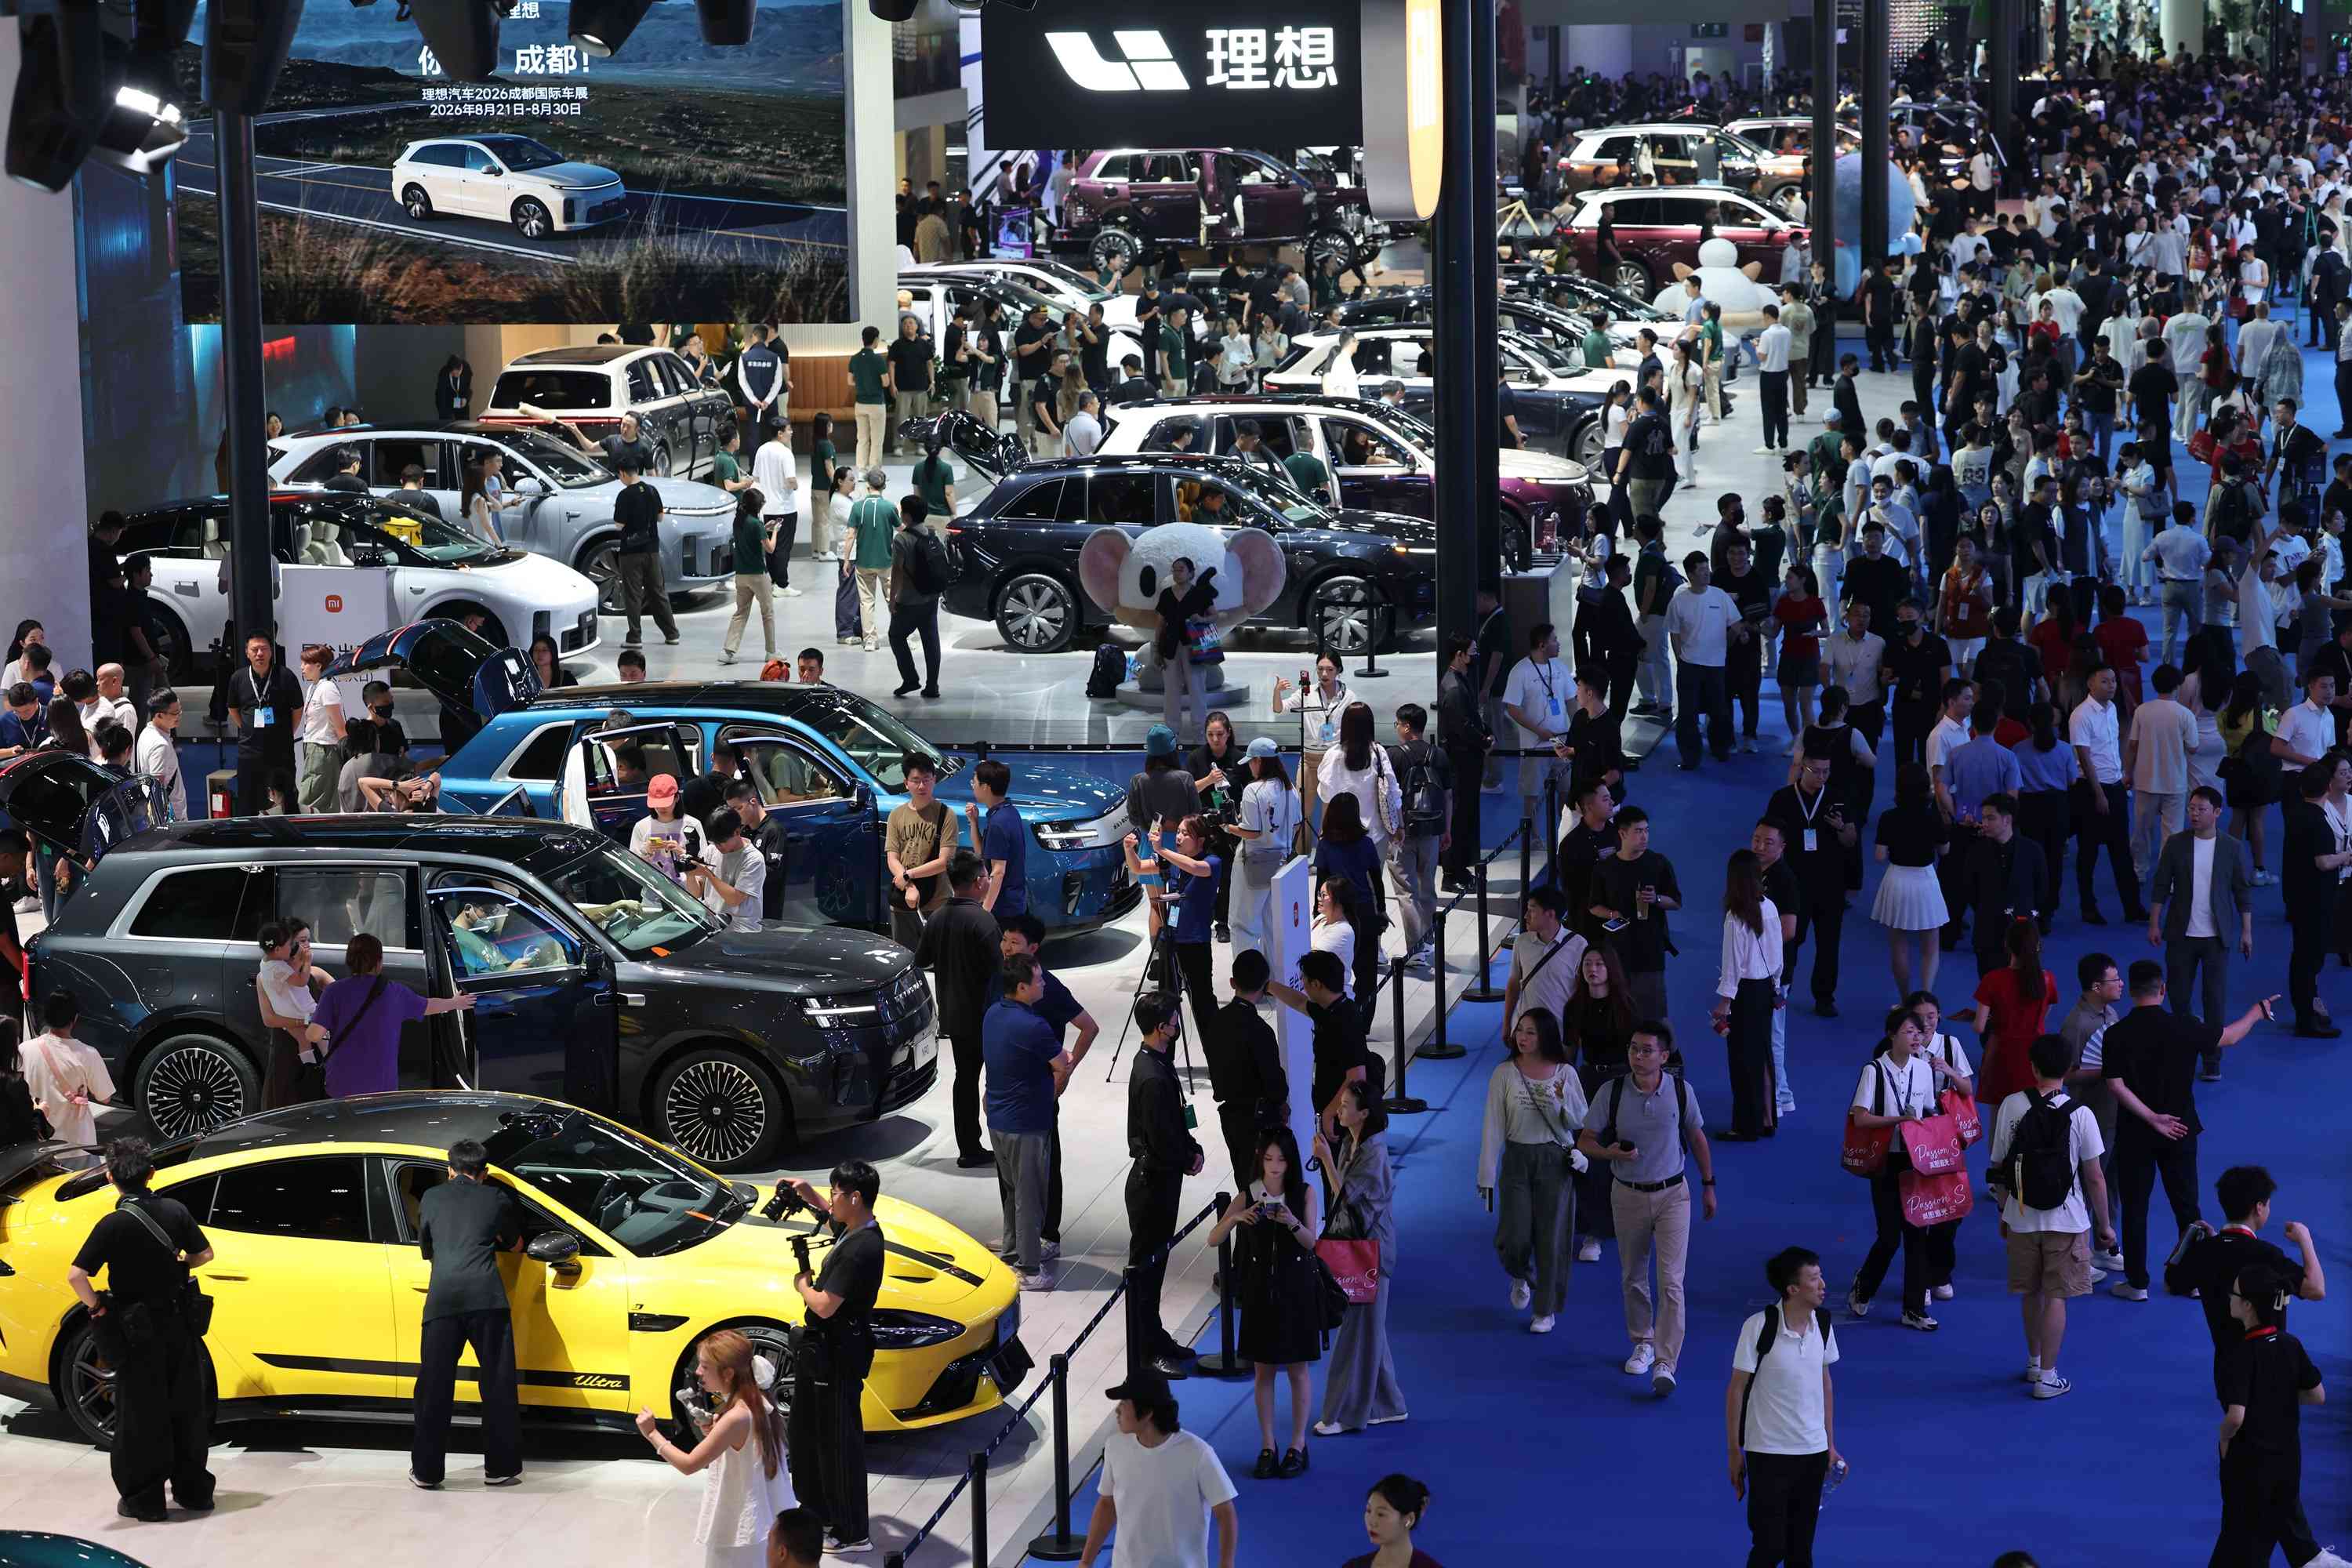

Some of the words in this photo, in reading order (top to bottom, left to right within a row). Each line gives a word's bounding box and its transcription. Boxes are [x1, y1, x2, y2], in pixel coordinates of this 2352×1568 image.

[1205, 25, 1338, 89] 理想
[422, 86, 588, 101] 理想汽车2026成都国际车展
[430, 103, 581, 116] 2026年8月21日-8月30日
[1953, 1184, 1966, 1204] S
[574, 1374, 622, 1388] Ultra
